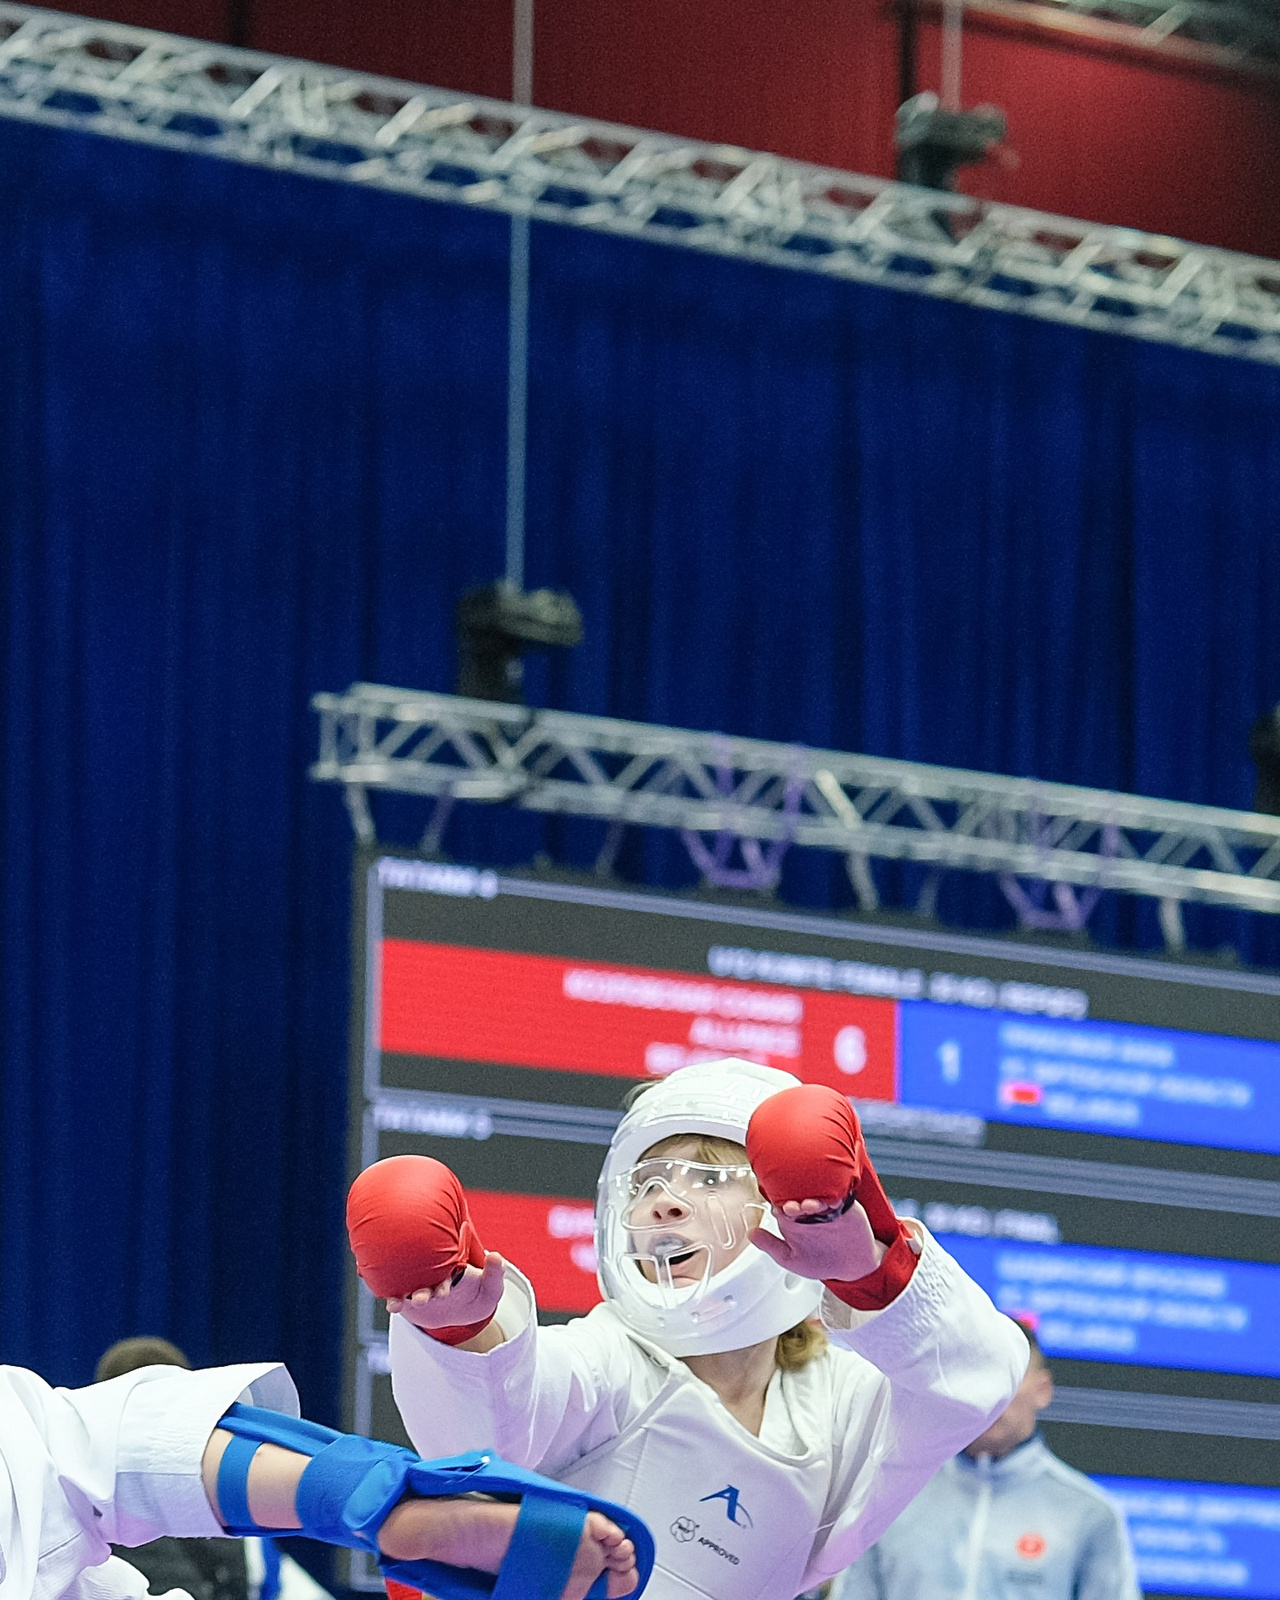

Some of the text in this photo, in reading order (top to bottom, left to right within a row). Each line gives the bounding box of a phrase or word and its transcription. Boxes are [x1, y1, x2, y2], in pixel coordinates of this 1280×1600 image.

[836, 1027, 866, 1073] 6
[939, 1040, 961, 1083] 1
[698, 1537, 740, 1565] APPROVED
